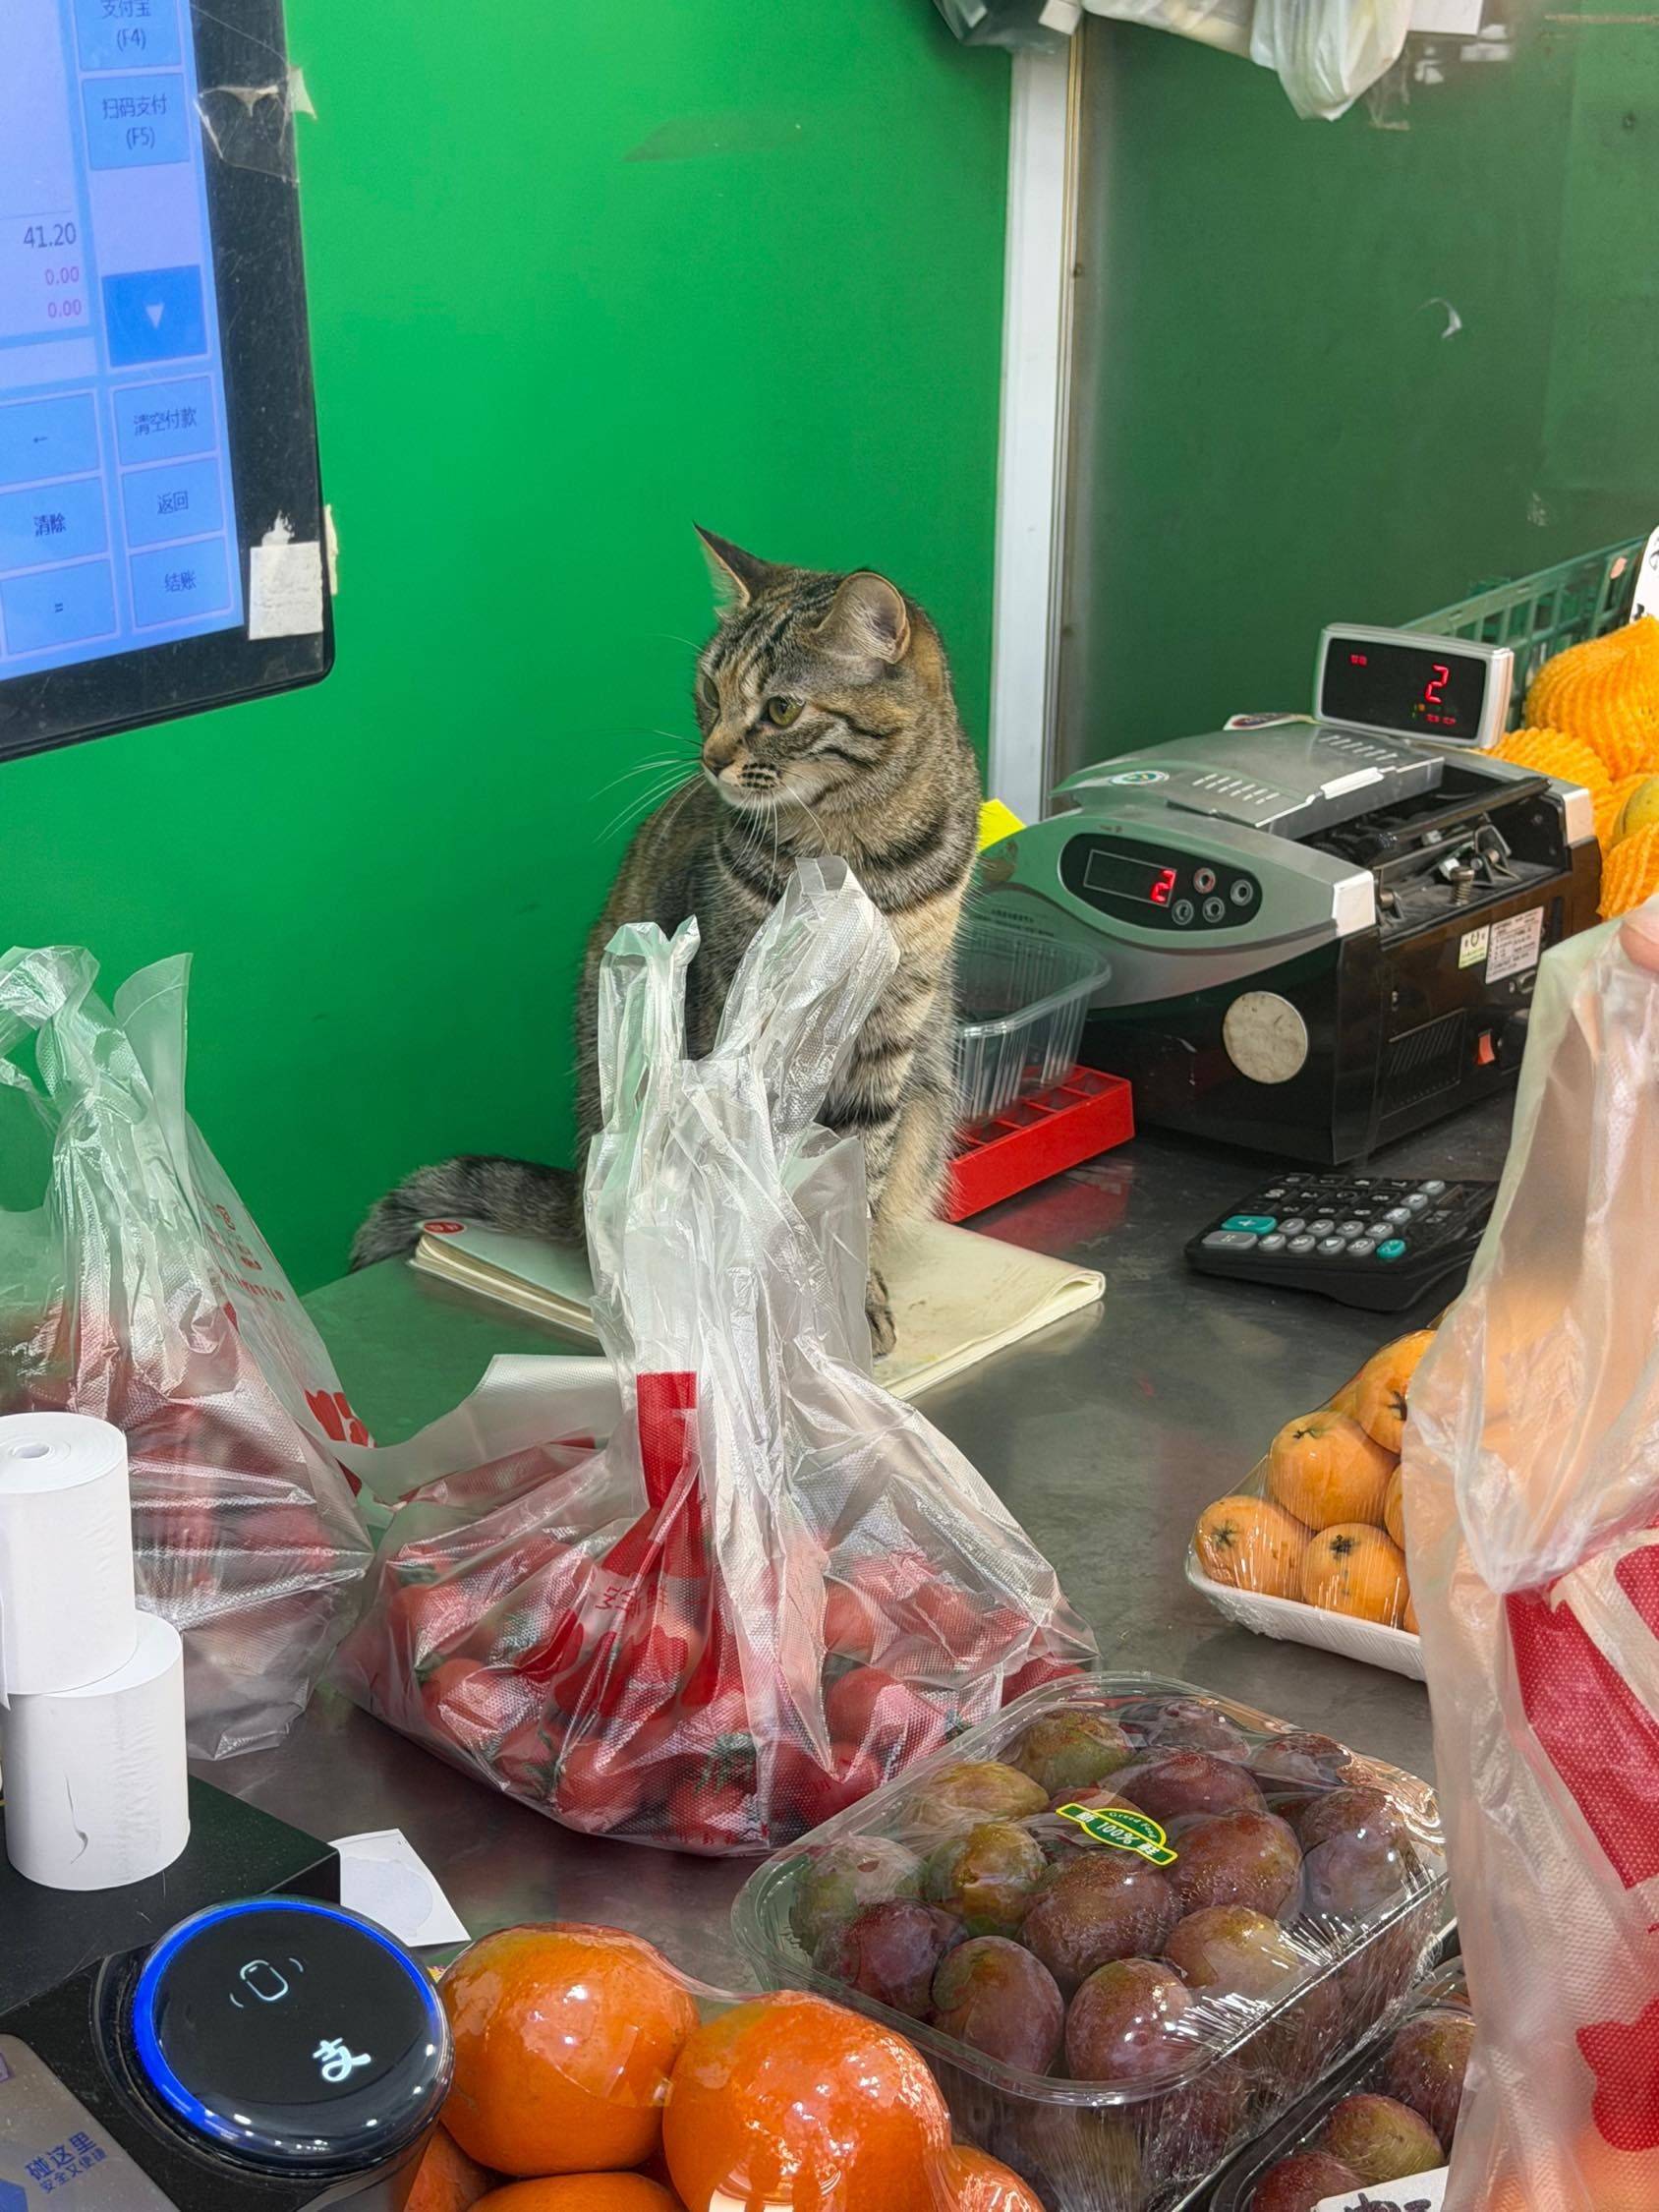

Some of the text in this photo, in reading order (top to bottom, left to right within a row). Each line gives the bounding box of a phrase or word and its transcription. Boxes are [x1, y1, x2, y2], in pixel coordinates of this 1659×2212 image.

[117, 28, 146, 52] (F4)
[102, 93, 167, 120] 扫码支付
[126, 125, 155, 150] (F5)
[23, 222, 77, 249] 41.20
[44, 266, 80, 286] 0.00
[47, 298, 83, 319] 0.00
[134, 407, 197, 437] 清空付款
[157, 491, 189, 514] 返回
[33, 513, 66, 536] 清除
[164, 569, 197, 592] 结账
[1425, 662, 1450, 704] 2
[1150, 869, 1176, 903] 2
[1097, 1822, 1140, 1844] 100%
[25, 2130, 97, 2182] 碰这里
